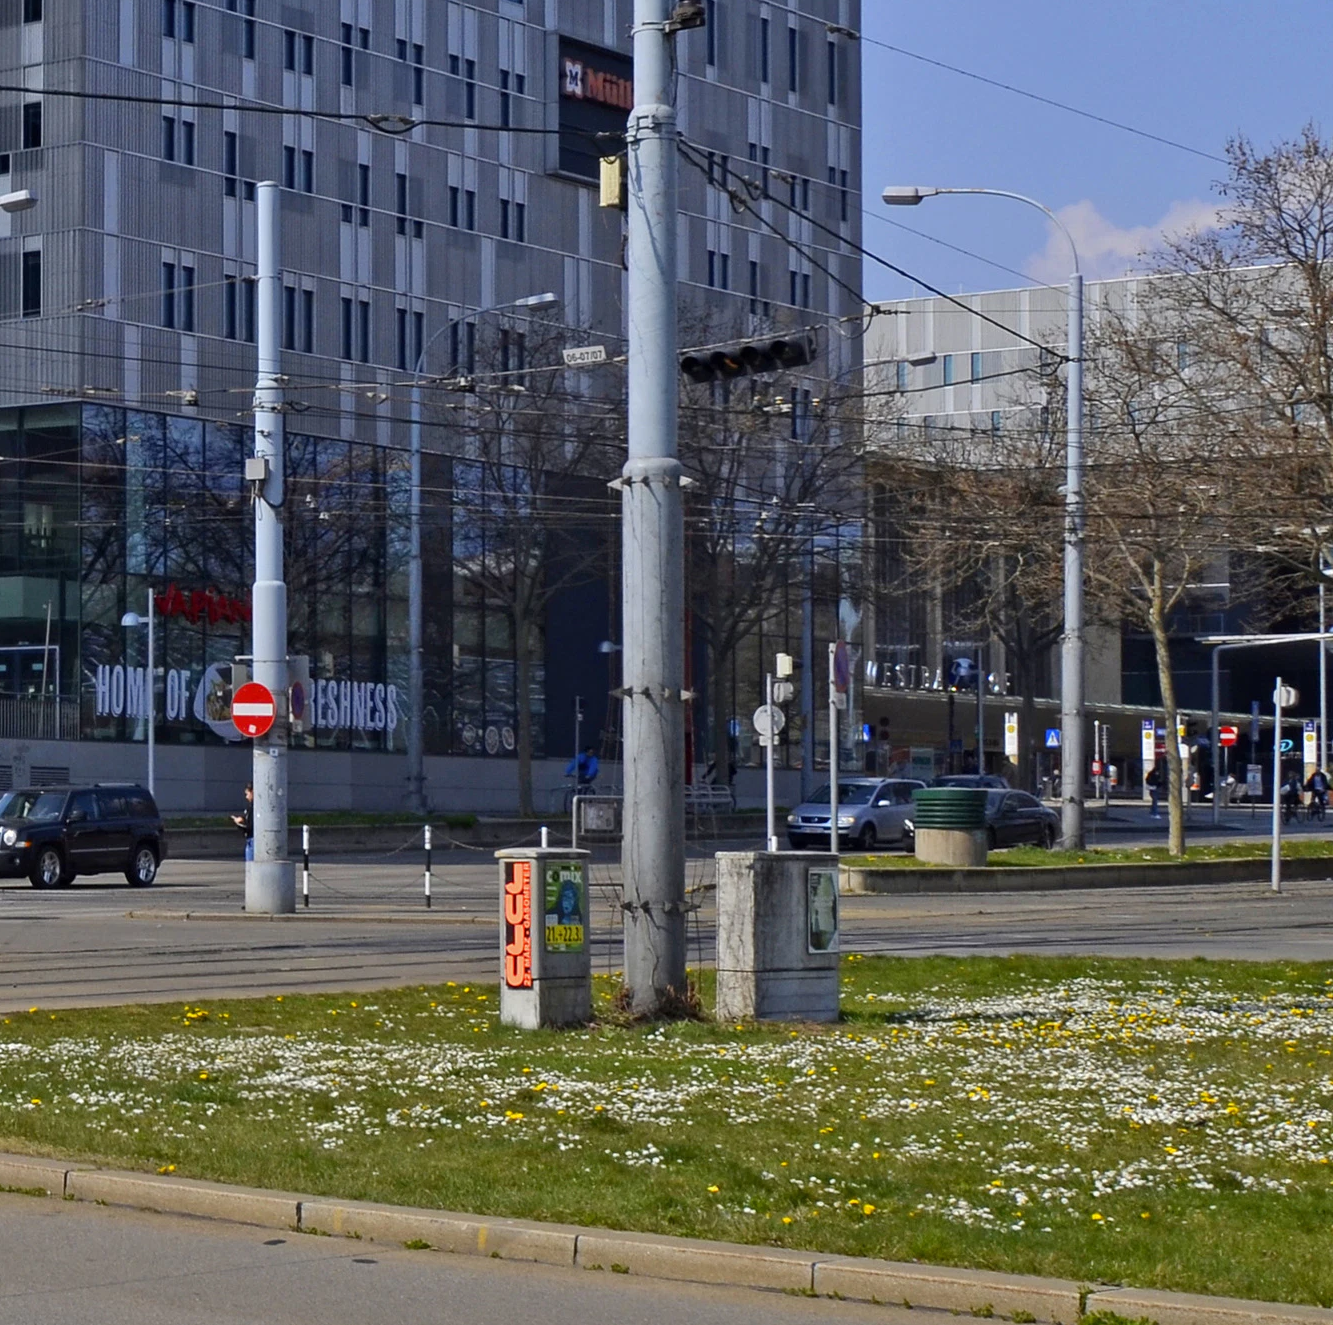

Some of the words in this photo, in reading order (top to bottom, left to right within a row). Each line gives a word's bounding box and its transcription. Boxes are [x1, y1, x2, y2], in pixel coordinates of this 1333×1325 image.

[585, 67, 632, 109] Müll
[166, 668, 191, 720] OF
[522, 862, 531, 929] GASOMETER
